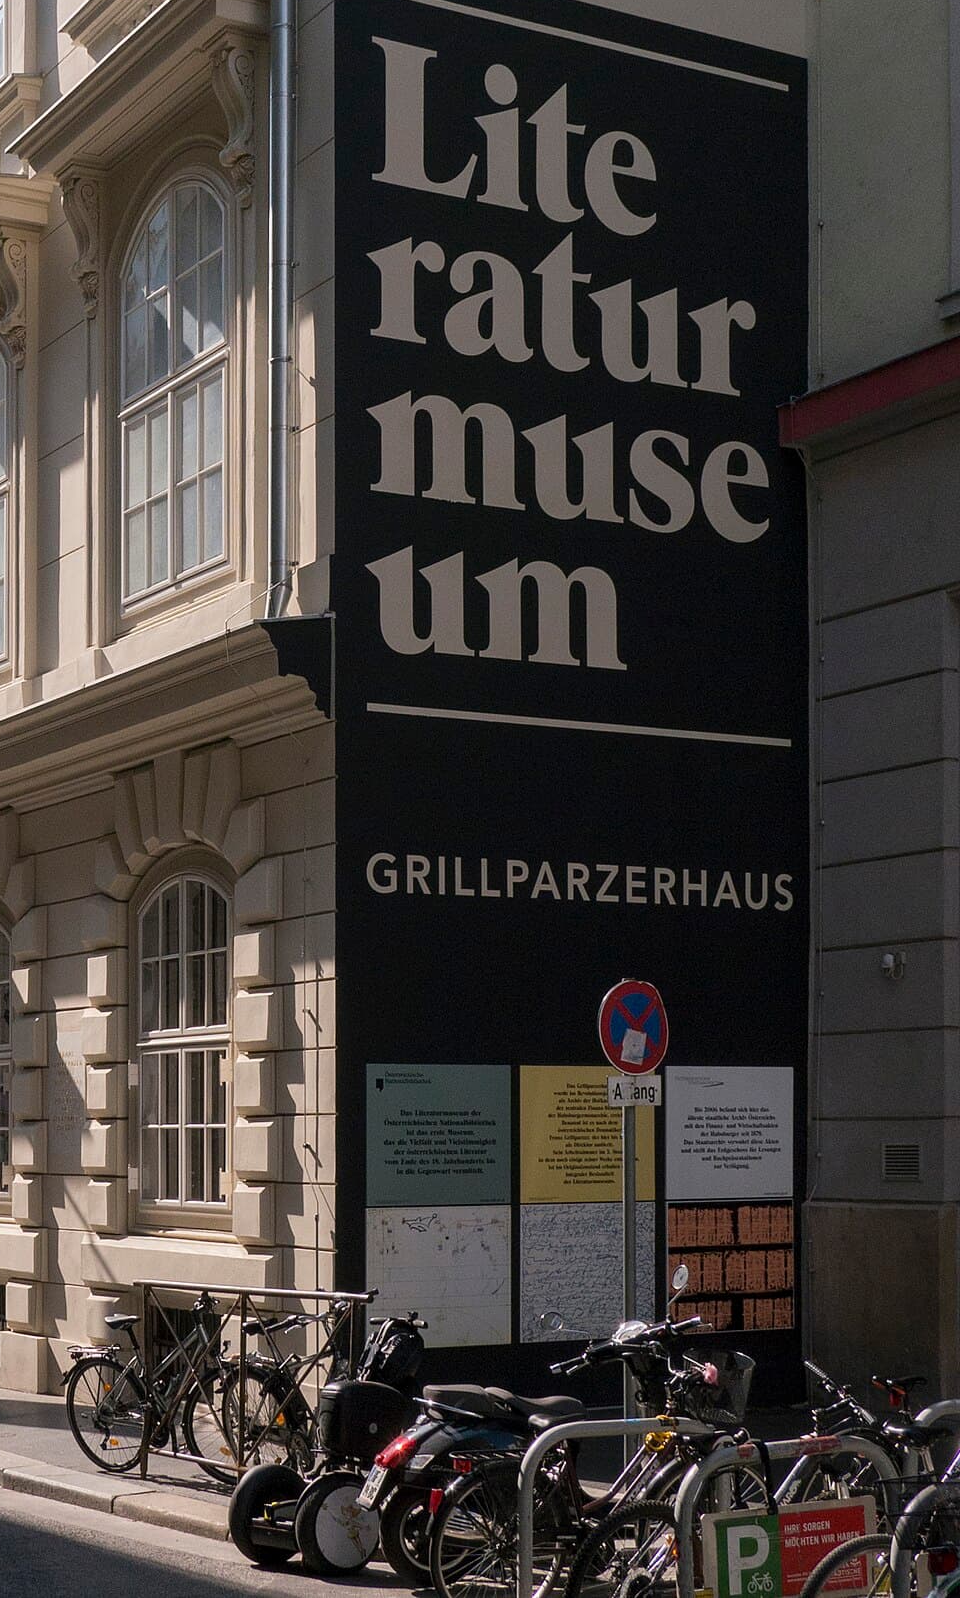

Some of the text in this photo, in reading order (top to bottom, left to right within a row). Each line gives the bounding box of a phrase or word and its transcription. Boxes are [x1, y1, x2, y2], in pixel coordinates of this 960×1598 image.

[371, 35, 657, 236] Lite
[366, 231, 756, 397] ratur
[365, 389, 770, 543] muse
[364, 545, 628, 671] um
[366, 852, 794, 912] GRILLPARZERHAUS
[614, 1083, 656, 1103] Aang
[726, 1524, 770, 1595] P
[784, 1534, 819, 1548] MÖCHTEN
[821, 1533, 836, 1544] WIR
[802, 1520, 831, 1532] SORGEN
